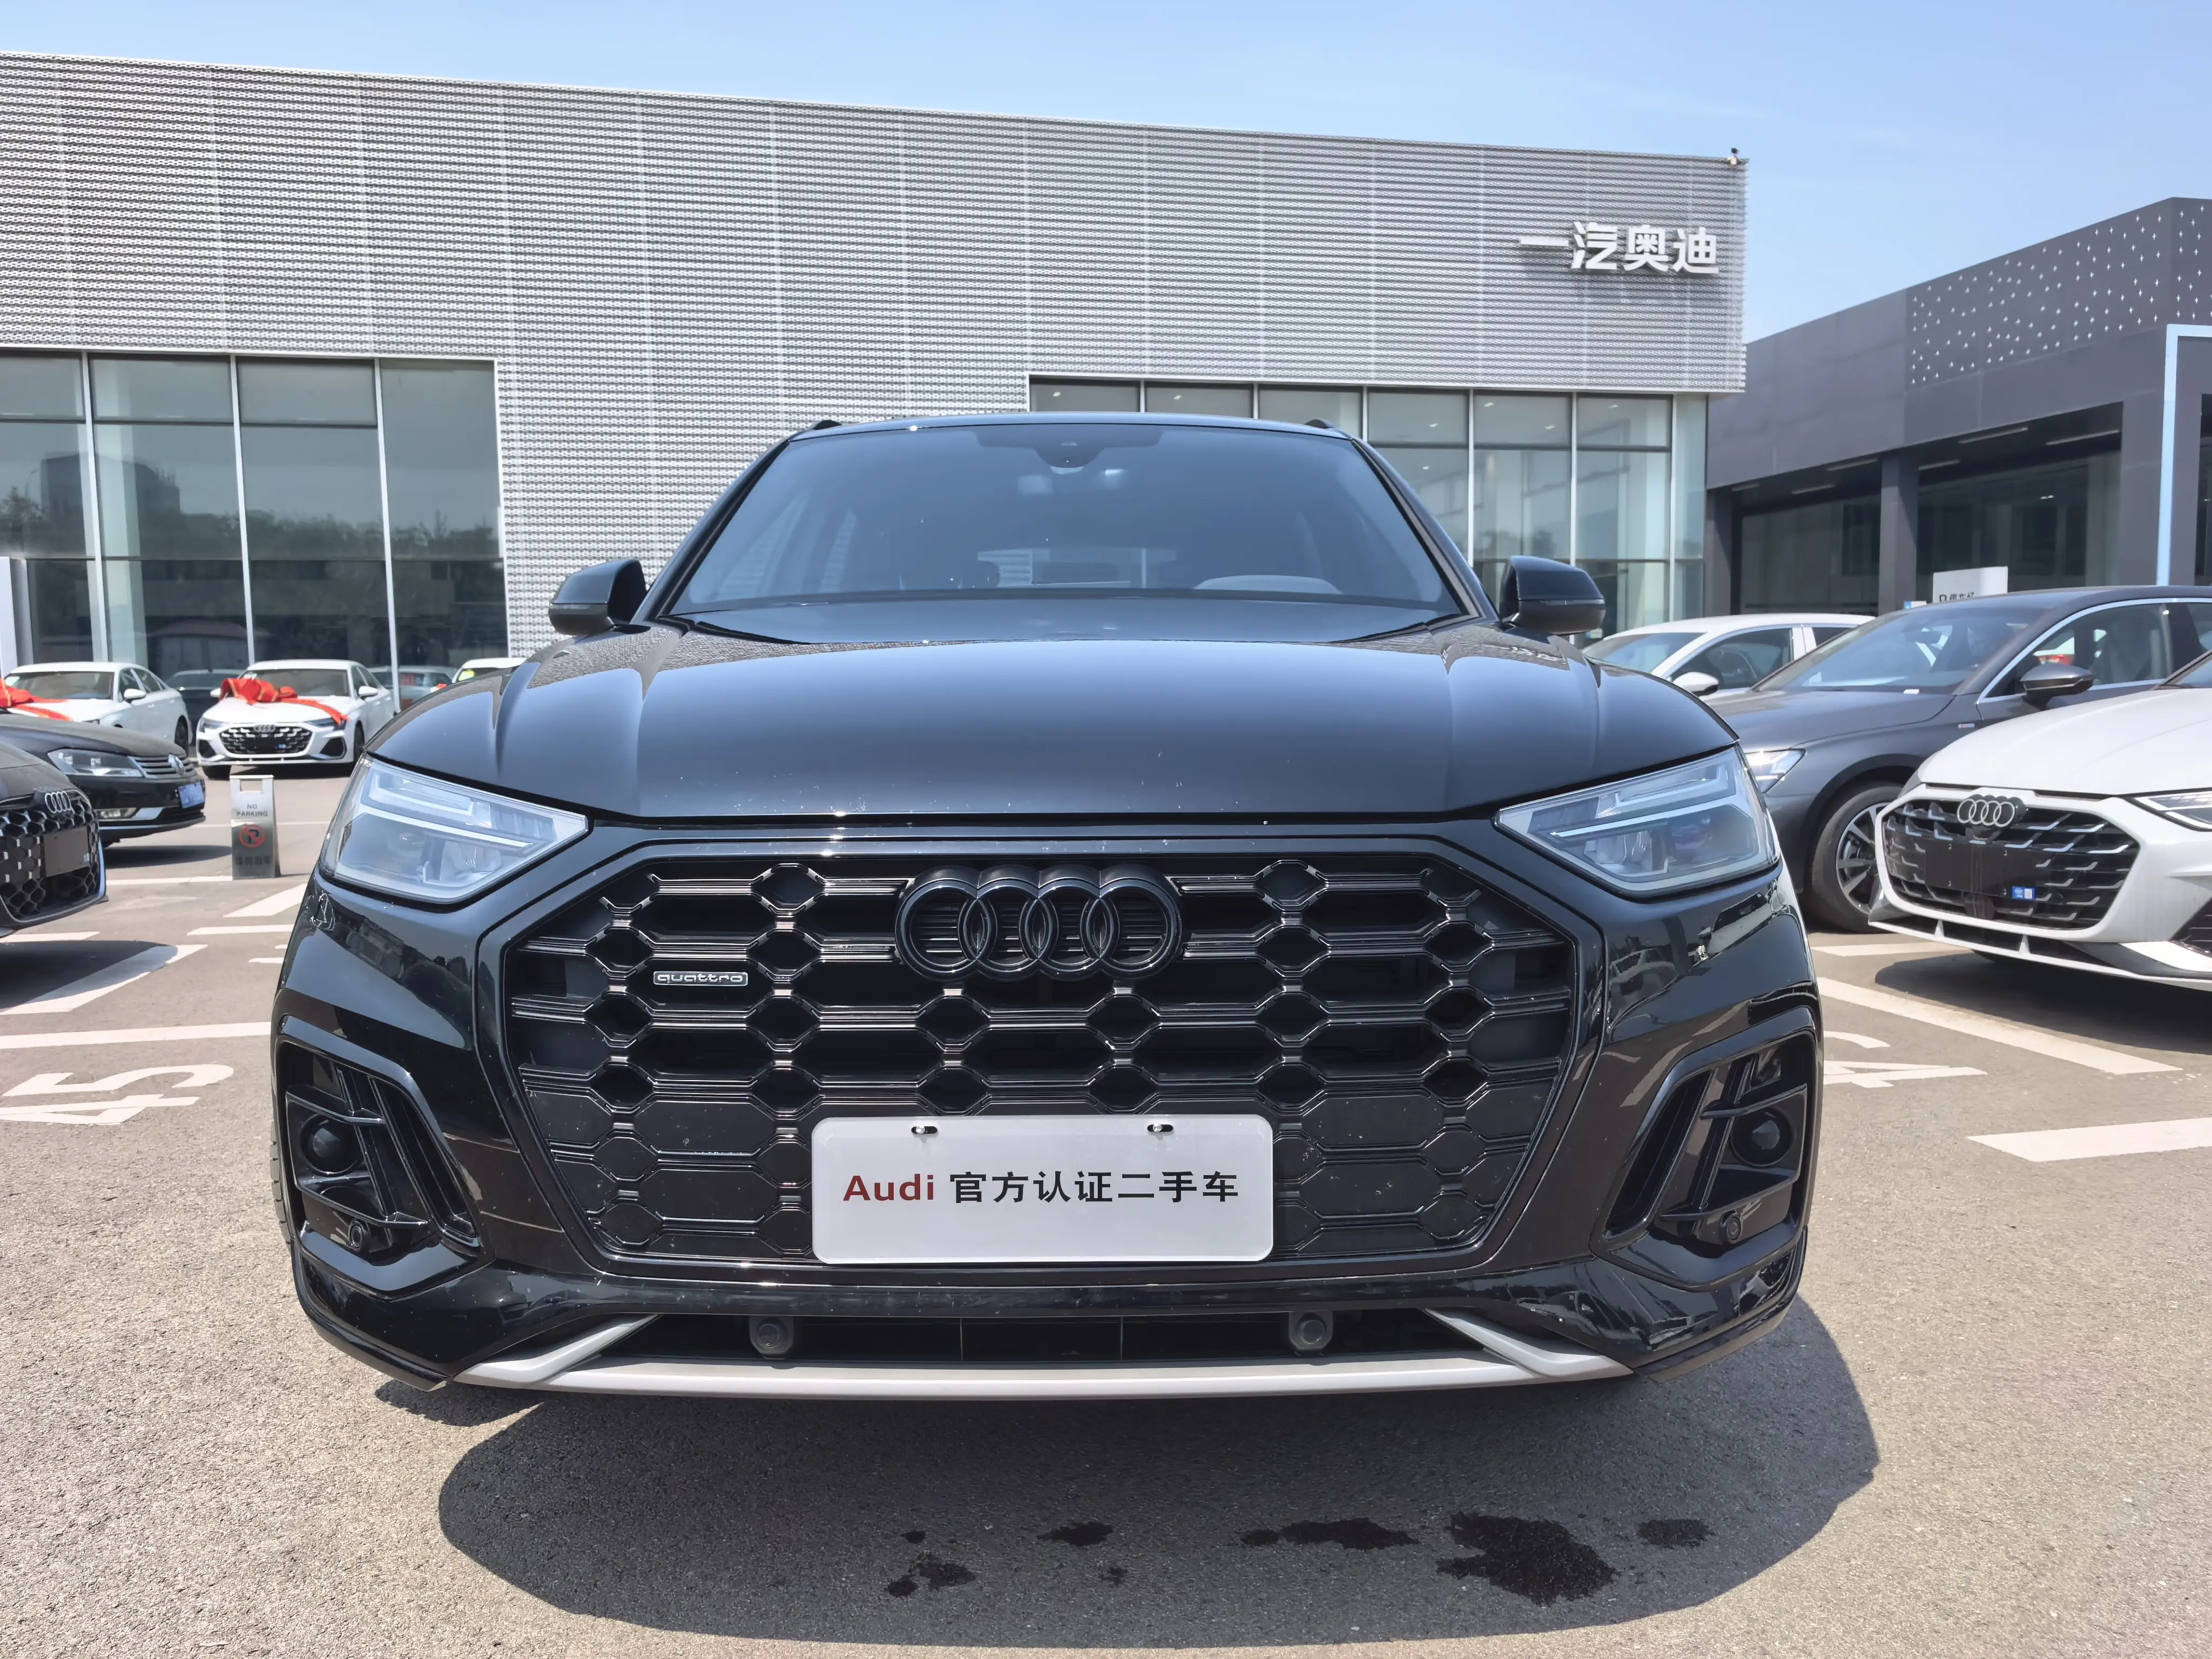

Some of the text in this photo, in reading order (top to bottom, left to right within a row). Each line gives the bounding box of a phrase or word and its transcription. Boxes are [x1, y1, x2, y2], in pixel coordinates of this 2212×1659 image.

[1520, 221, 1719, 274] 一汽奥迪
[657, 974, 744, 983] quattro
[843, 1171, 1238, 1203] Audi 官方认证二手车
